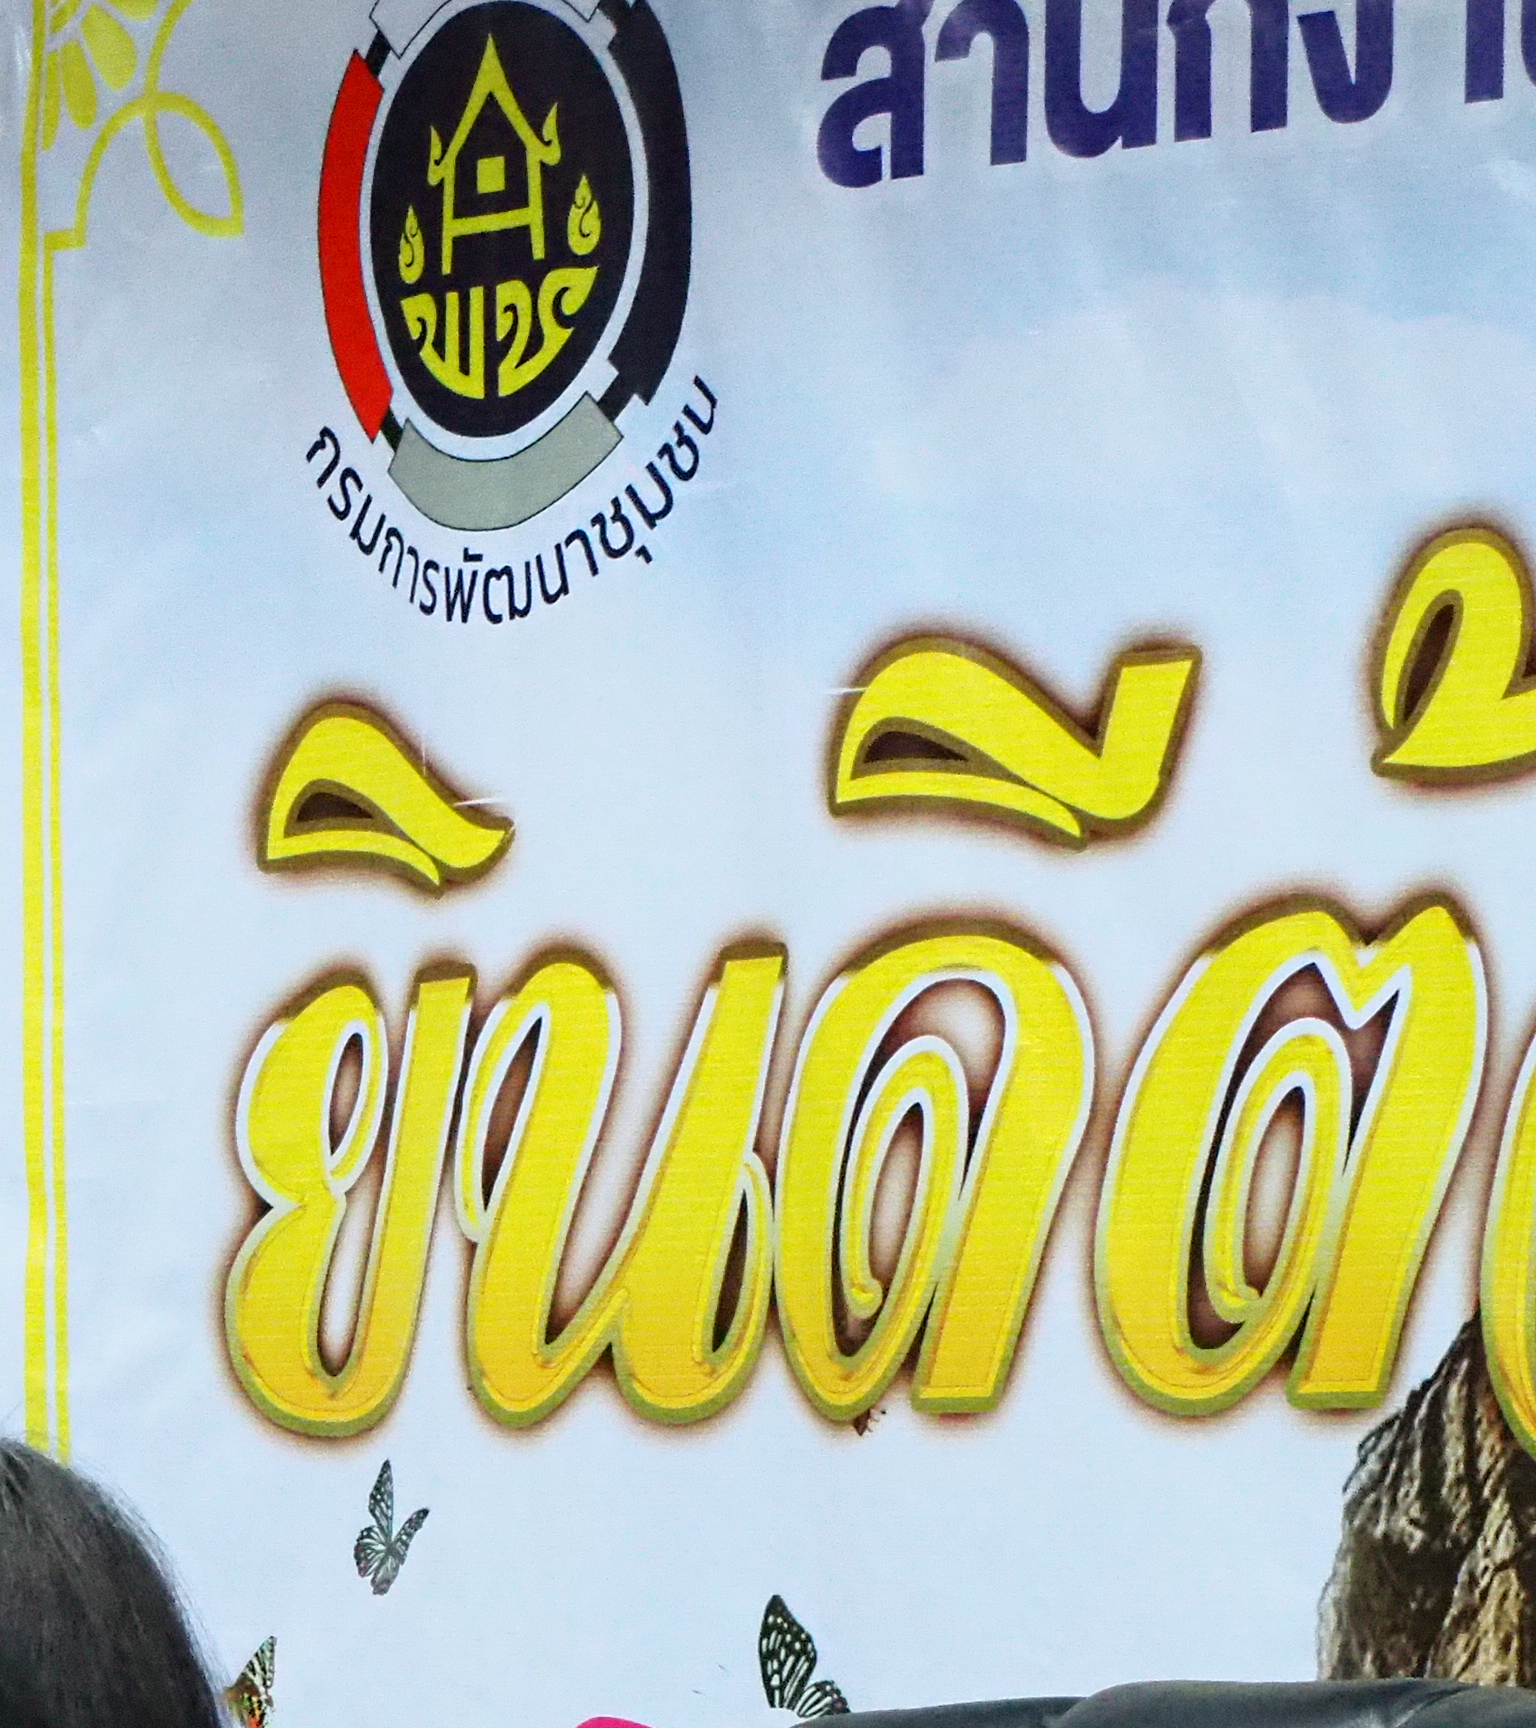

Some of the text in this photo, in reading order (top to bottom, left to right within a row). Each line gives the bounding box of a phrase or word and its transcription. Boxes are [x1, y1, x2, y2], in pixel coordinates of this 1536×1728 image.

[306, 375, 718, 624] กรมการพัฒนาชุมชน
